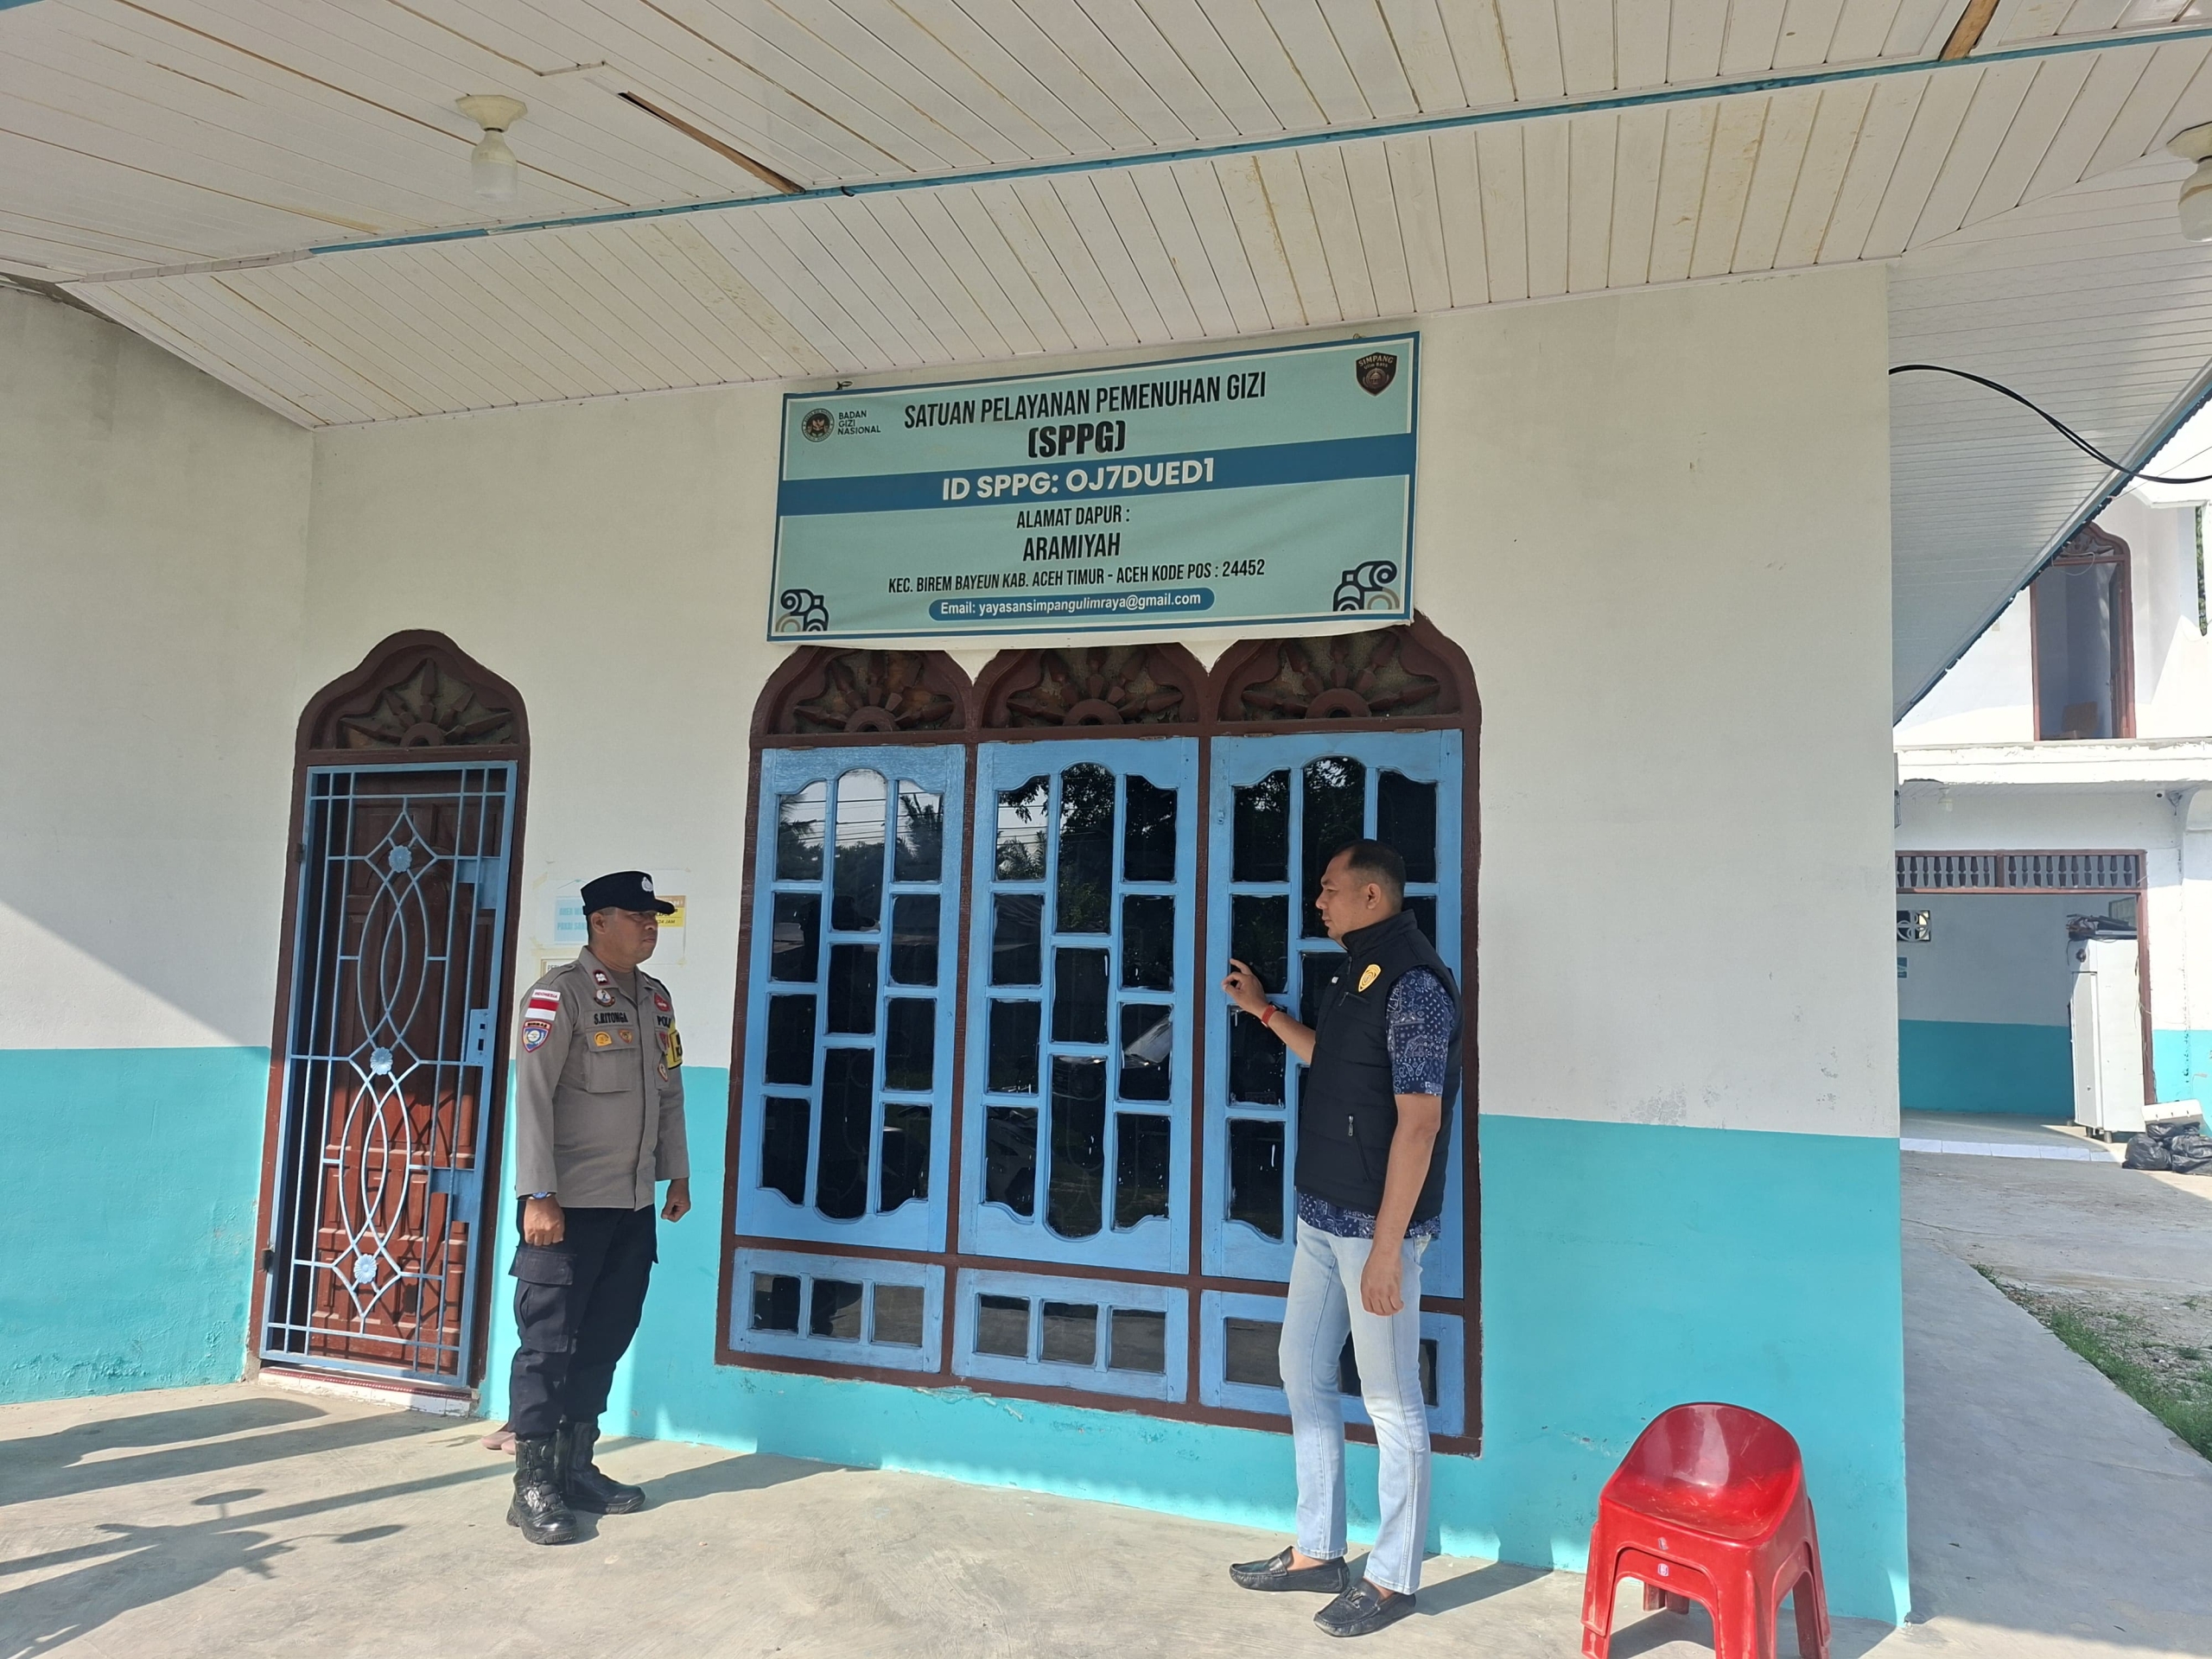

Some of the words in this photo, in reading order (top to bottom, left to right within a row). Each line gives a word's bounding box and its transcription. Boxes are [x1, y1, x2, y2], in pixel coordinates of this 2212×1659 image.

[1358, 355, 1394, 366] SIMPANG
[905, 400, 976, 429] SATUAN
[981, 389, 1090, 423] PELAYANAN
[1096, 376, 1220, 413] PEMENUHAN
[1227, 372, 1266, 400] GIZI
[838, 410, 867, 420] BADAN
[838, 419, 855, 428] GIZI
[837, 425, 881, 435] NASIONAL
[1028, 420, 1126, 458] (SPPG)
[943, 478, 970, 500] ID
[976, 472, 1059, 499] SPPG:
[1016, 508, 1072, 529] ALAMAT
[1076, 505, 1122, 525] DAPUR
[1022, 532, 1121, 562] ARAMIYAH
[888, 577, 913, 594] KEC.
[916, 575, 952, 592] BIREM
[955, 574, 1000, 590] BAYEUN
[1002, 572, 1029, 588] KAB.
[1032, 570, 1064, 587] ACEH
[1066, 568, 1104, 586] TIMUR
[1116, 565, 1148, 583] ACEH
[1152, 564, 1185, 582] KODE
[1187, 563, 1211, 579] POS
[1222, 558, 1265, 577] 24452
[941, 601, 976, 614] Email:
[979, 593, 1201, 616] yayasansimpangulimraya@gmail.com
[594, 1012, 629, 1026] S.RITONGA
